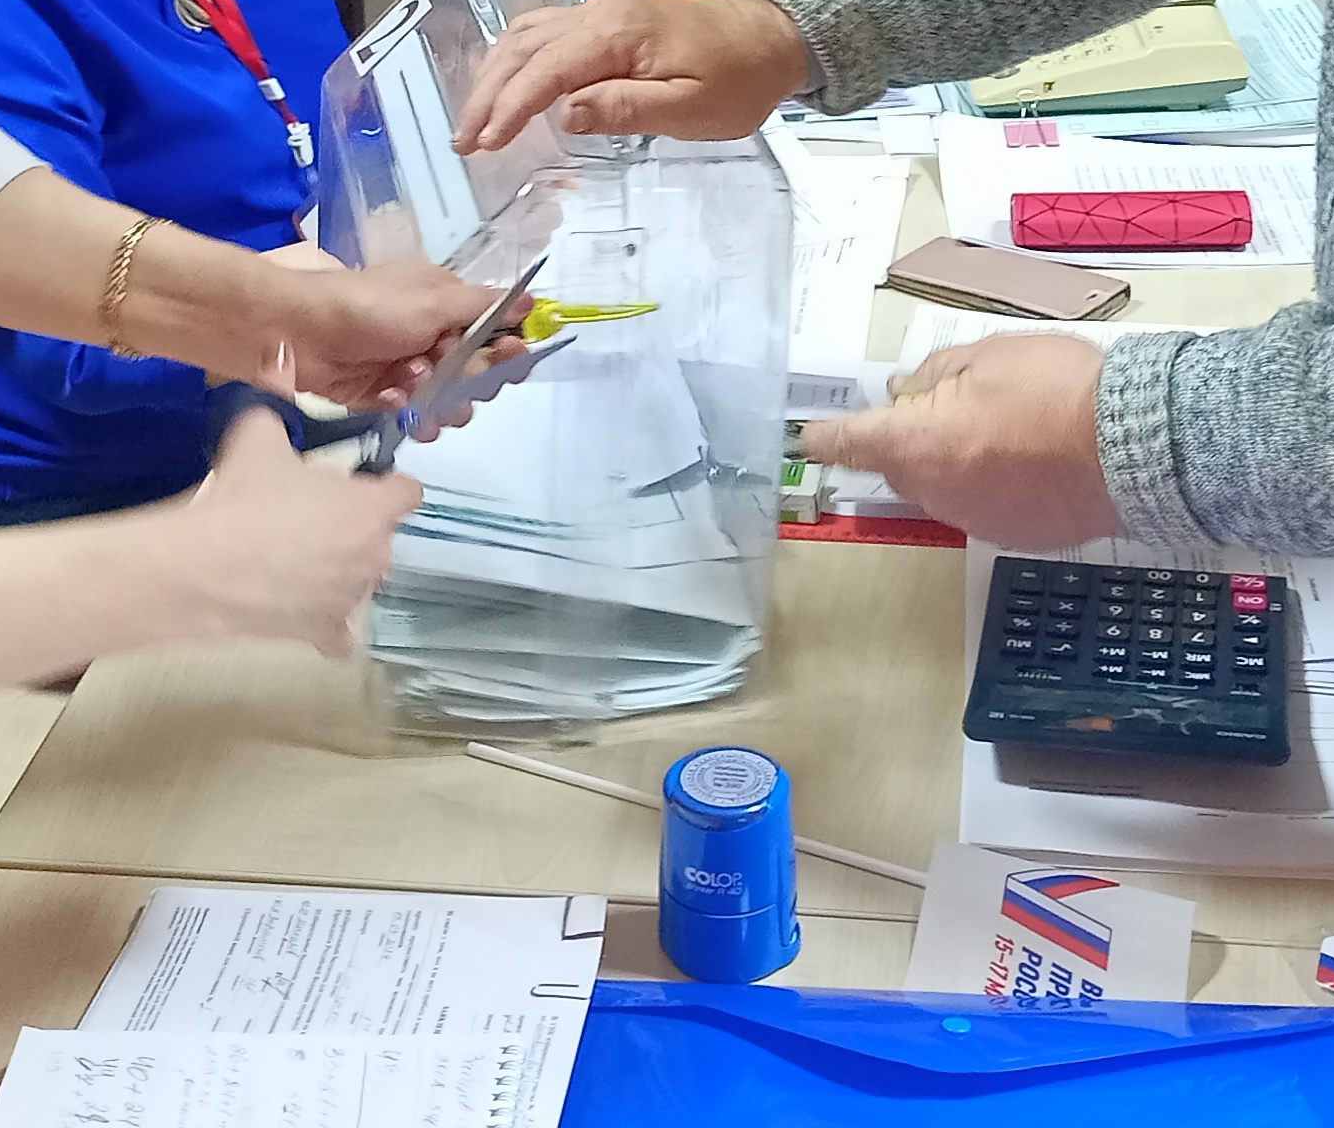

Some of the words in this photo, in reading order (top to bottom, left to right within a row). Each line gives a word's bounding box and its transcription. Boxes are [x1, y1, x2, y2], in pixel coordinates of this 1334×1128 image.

[357, 0, 420, 64] 2
[1196, 573, 1210, 583] 0
[1110, 586, 1124, 597] 3
[1151, 589, 1166, 599] 2
[1195, 592, 1205, 602] 1
[1237, 595, 1265, 605] ON
[1108, 605, 1124, 616] 6
[1149, 608, 1164, 620] 5
[1191, 611, 1207, 622] 4
[1106, 625, 1121, 637] 9
[1148, 628, 1163, 640] 8
[1191, 632, 1206, 643] 7
[1006, 639, 1032, 649] MU
[1185, 652, 1212, 663] MR
[1235, 656, 1265, 667] MC
[684, 866, 743, 887] COLOP
